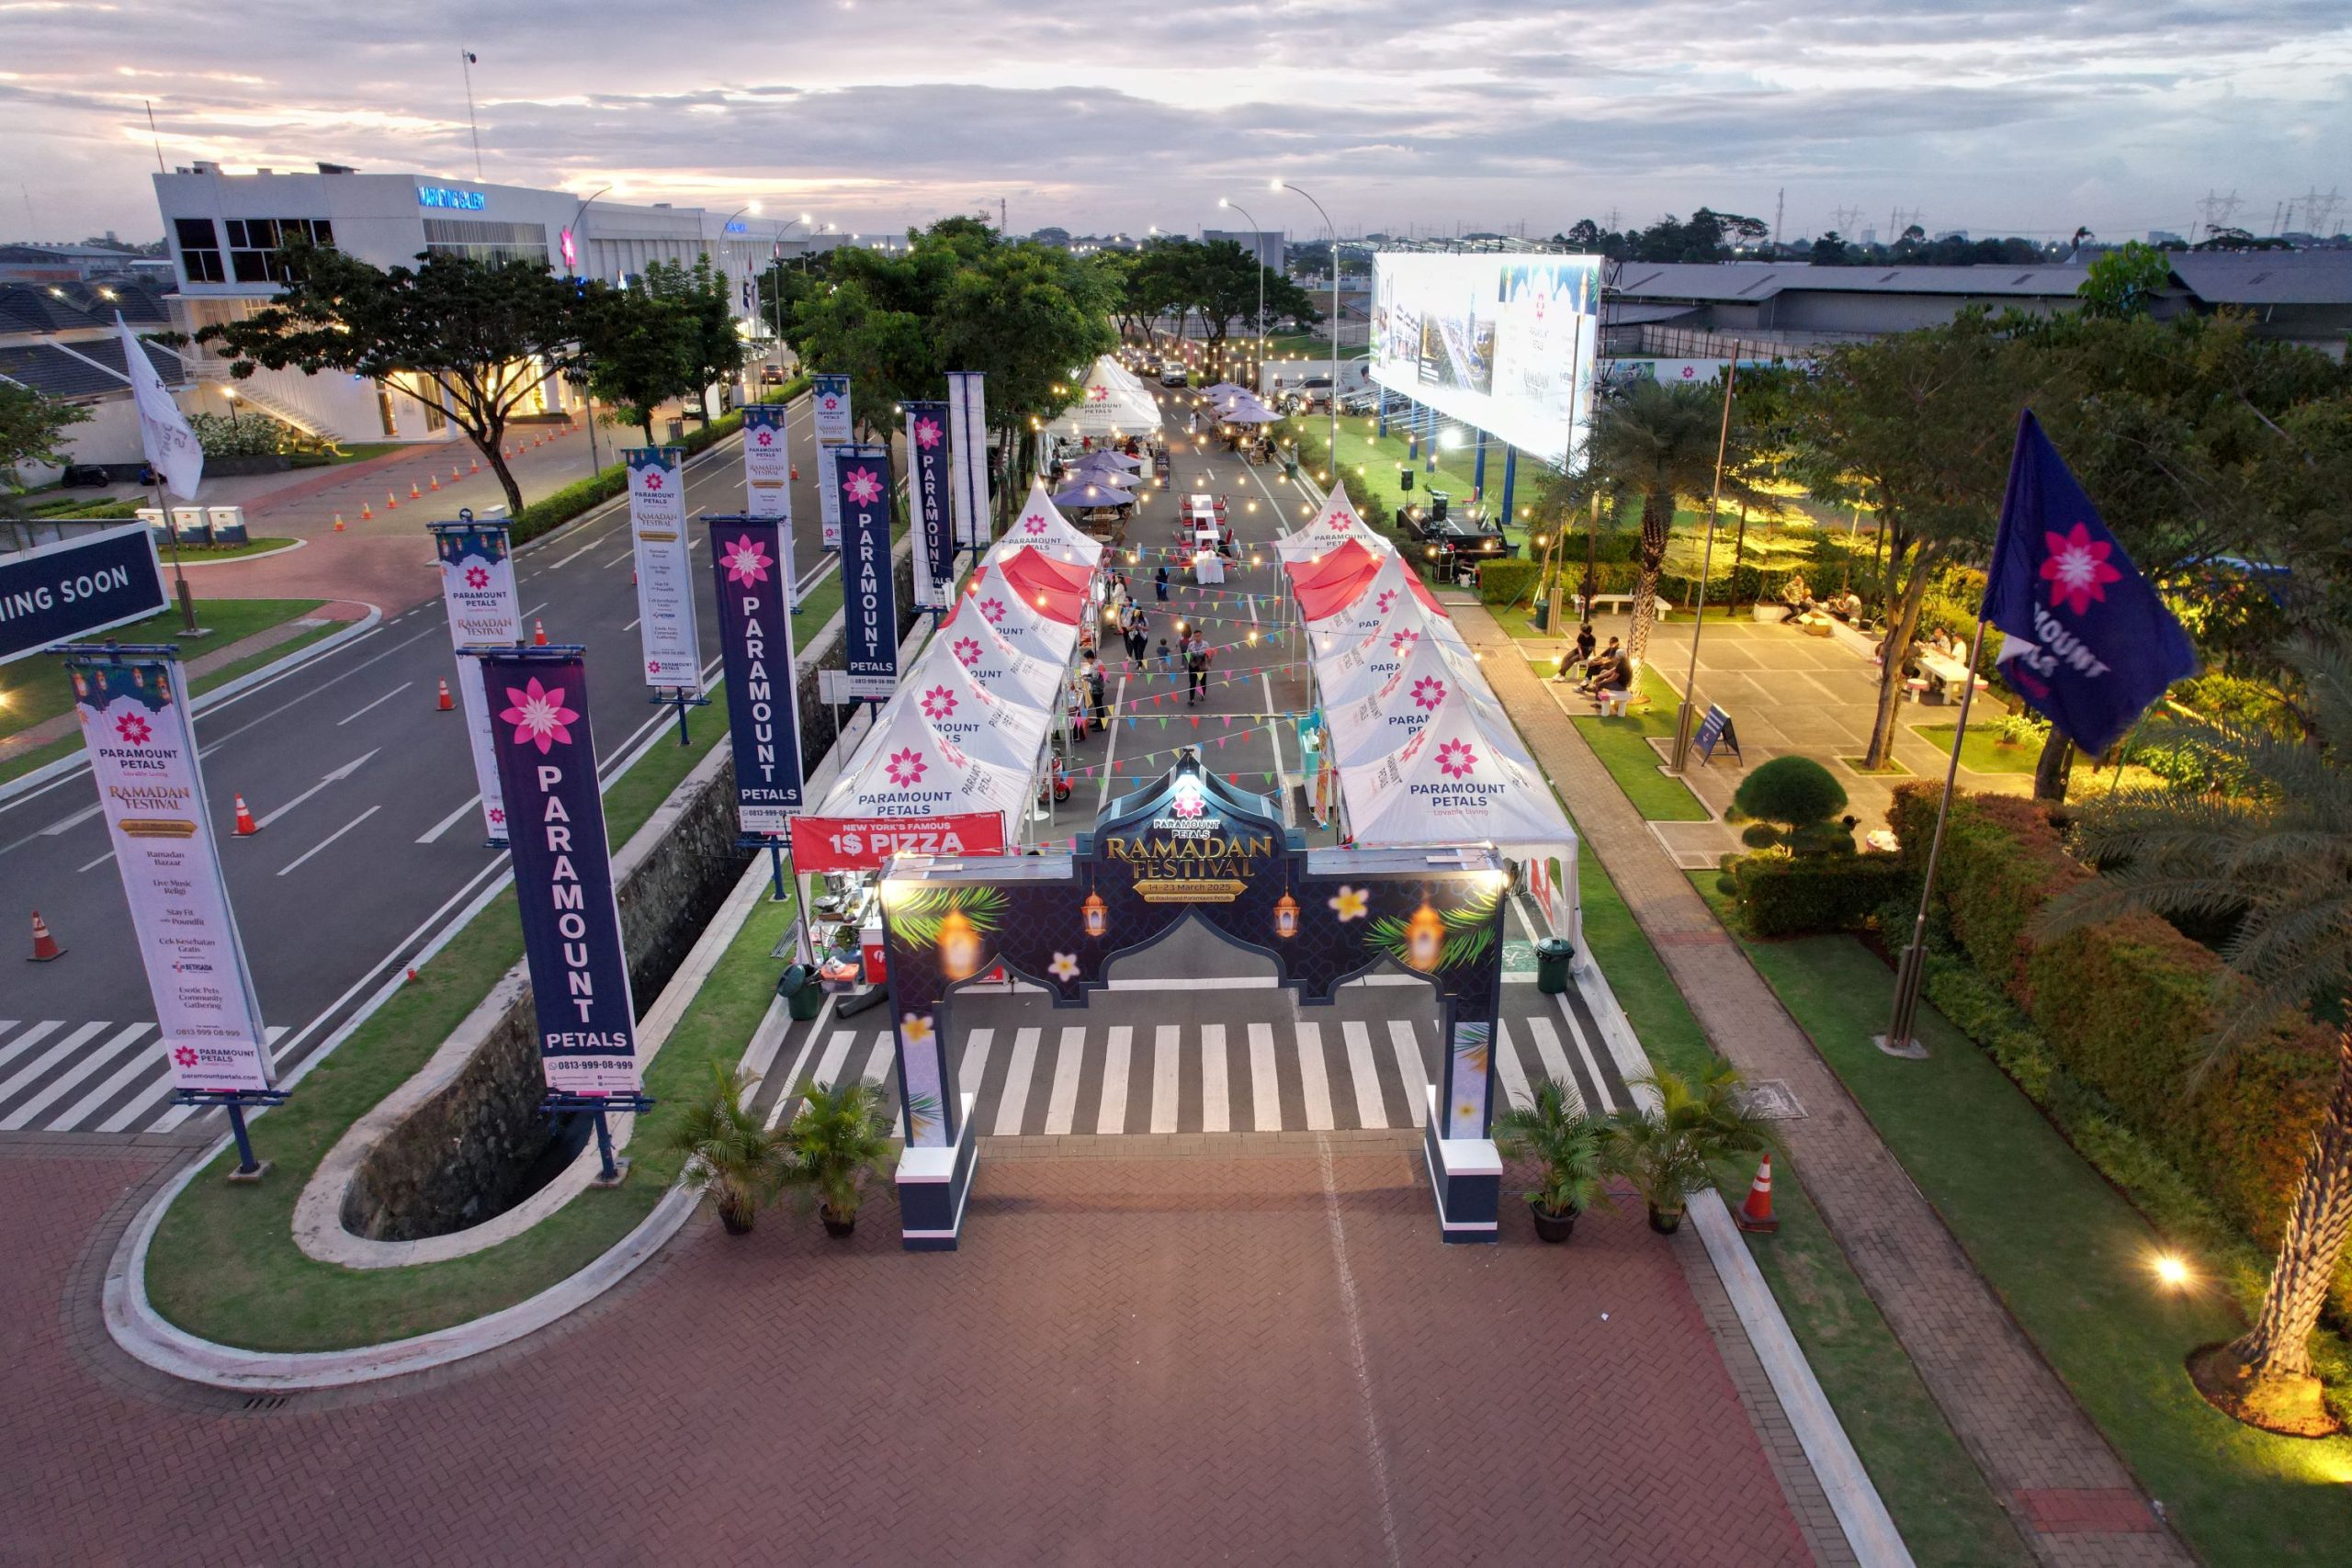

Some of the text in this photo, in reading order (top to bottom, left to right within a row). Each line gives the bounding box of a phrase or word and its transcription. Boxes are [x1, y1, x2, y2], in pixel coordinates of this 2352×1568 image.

[923, 456, 939, 573] PARAMOUNT
[60, 565, 129, 603] SOON
[858, 513, 877, 657] PARAMOUNT
[453, 591, 506, 599] PARAMOUNT
[458, 618, 513, 629] RAMADAN
[850, 661, 894, 671] PETALS
[742, 596, 775, 783] PARAMOUNT
[99, 749, 177, 759] PARAMOUNT
[119, 760, 166, 769] PETALS
[108, 785, 191, 800] RAMADAN
[741, 789, 798, 800] PETALS
[1410, 783, 1506, 795] PARAMOUNT
[858, 791, 953, 805] PARAMOUNT
[1432, 796, 1487, 807] PETALS
[124, 798, 182, 810] FESTIVAL
[876, 805, 931, 816] PETALS
[1465, 808, 1489, 817] Living
[842, 822, 951, 831] NEW YORK'S FAMOUS
[1153, 819, 1221, 829] PARAMOUNT
[1171, 830, 1211, 840] PETALS
[829, 832, 965, 857] 1$ PIZZA
[1106, 837, 1272, 863] RAMADAN
[147, 851, 186, 859] Ramadan
[1132, 858, 1256, 879] FESTIVAL
[170, 880, 192, 888] Music
[537, 765, 594, 1023] PARAMOUNT
[178, 994, 222, 1002] Community
[184, 1002, 222, 1011] Gathering
[546, 1032, 628, 1049] PETALS
[198, 1048, 254, 1056] PARAMOUNT
[558, 1061, 634, 1070] 0813-999-08-999
